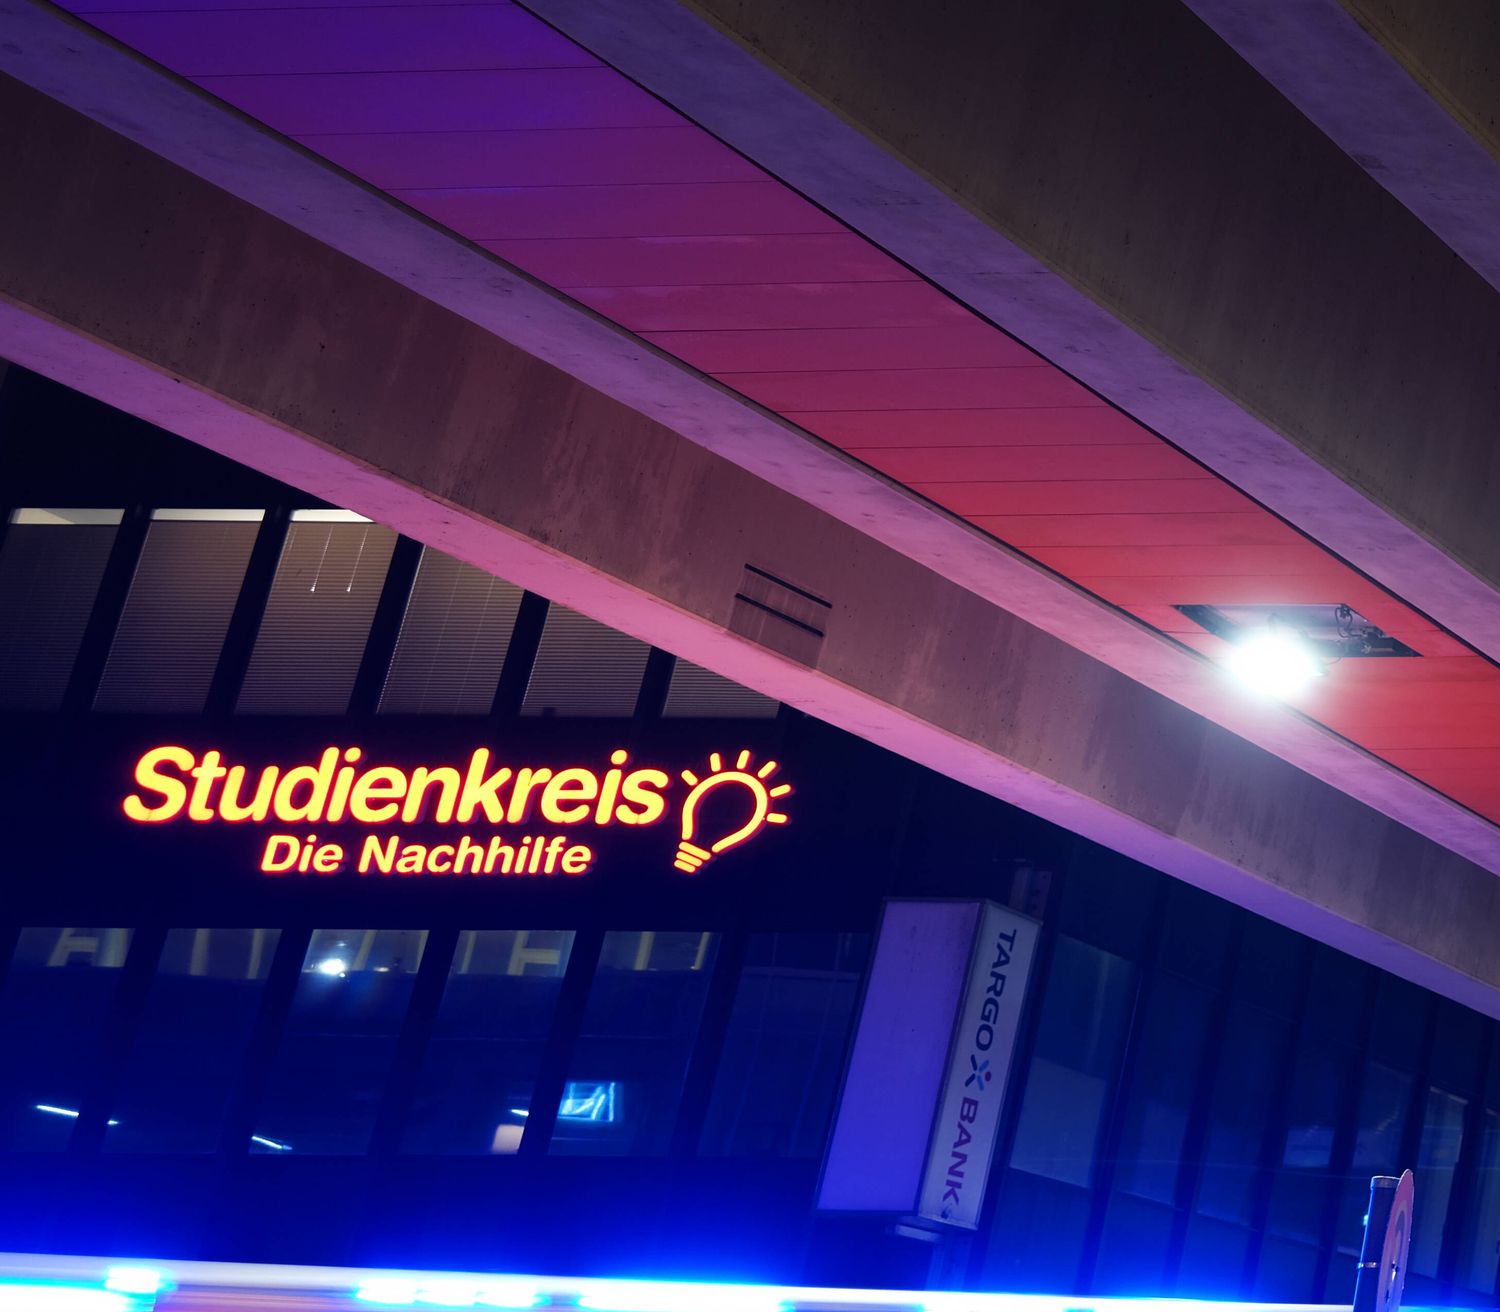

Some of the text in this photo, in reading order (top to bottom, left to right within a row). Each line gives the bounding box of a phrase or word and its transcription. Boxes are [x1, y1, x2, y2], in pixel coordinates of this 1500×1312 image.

[123, 745, 669, 825] Studienkreis
[260, 834, 592, 876] Die Nachhilfe
